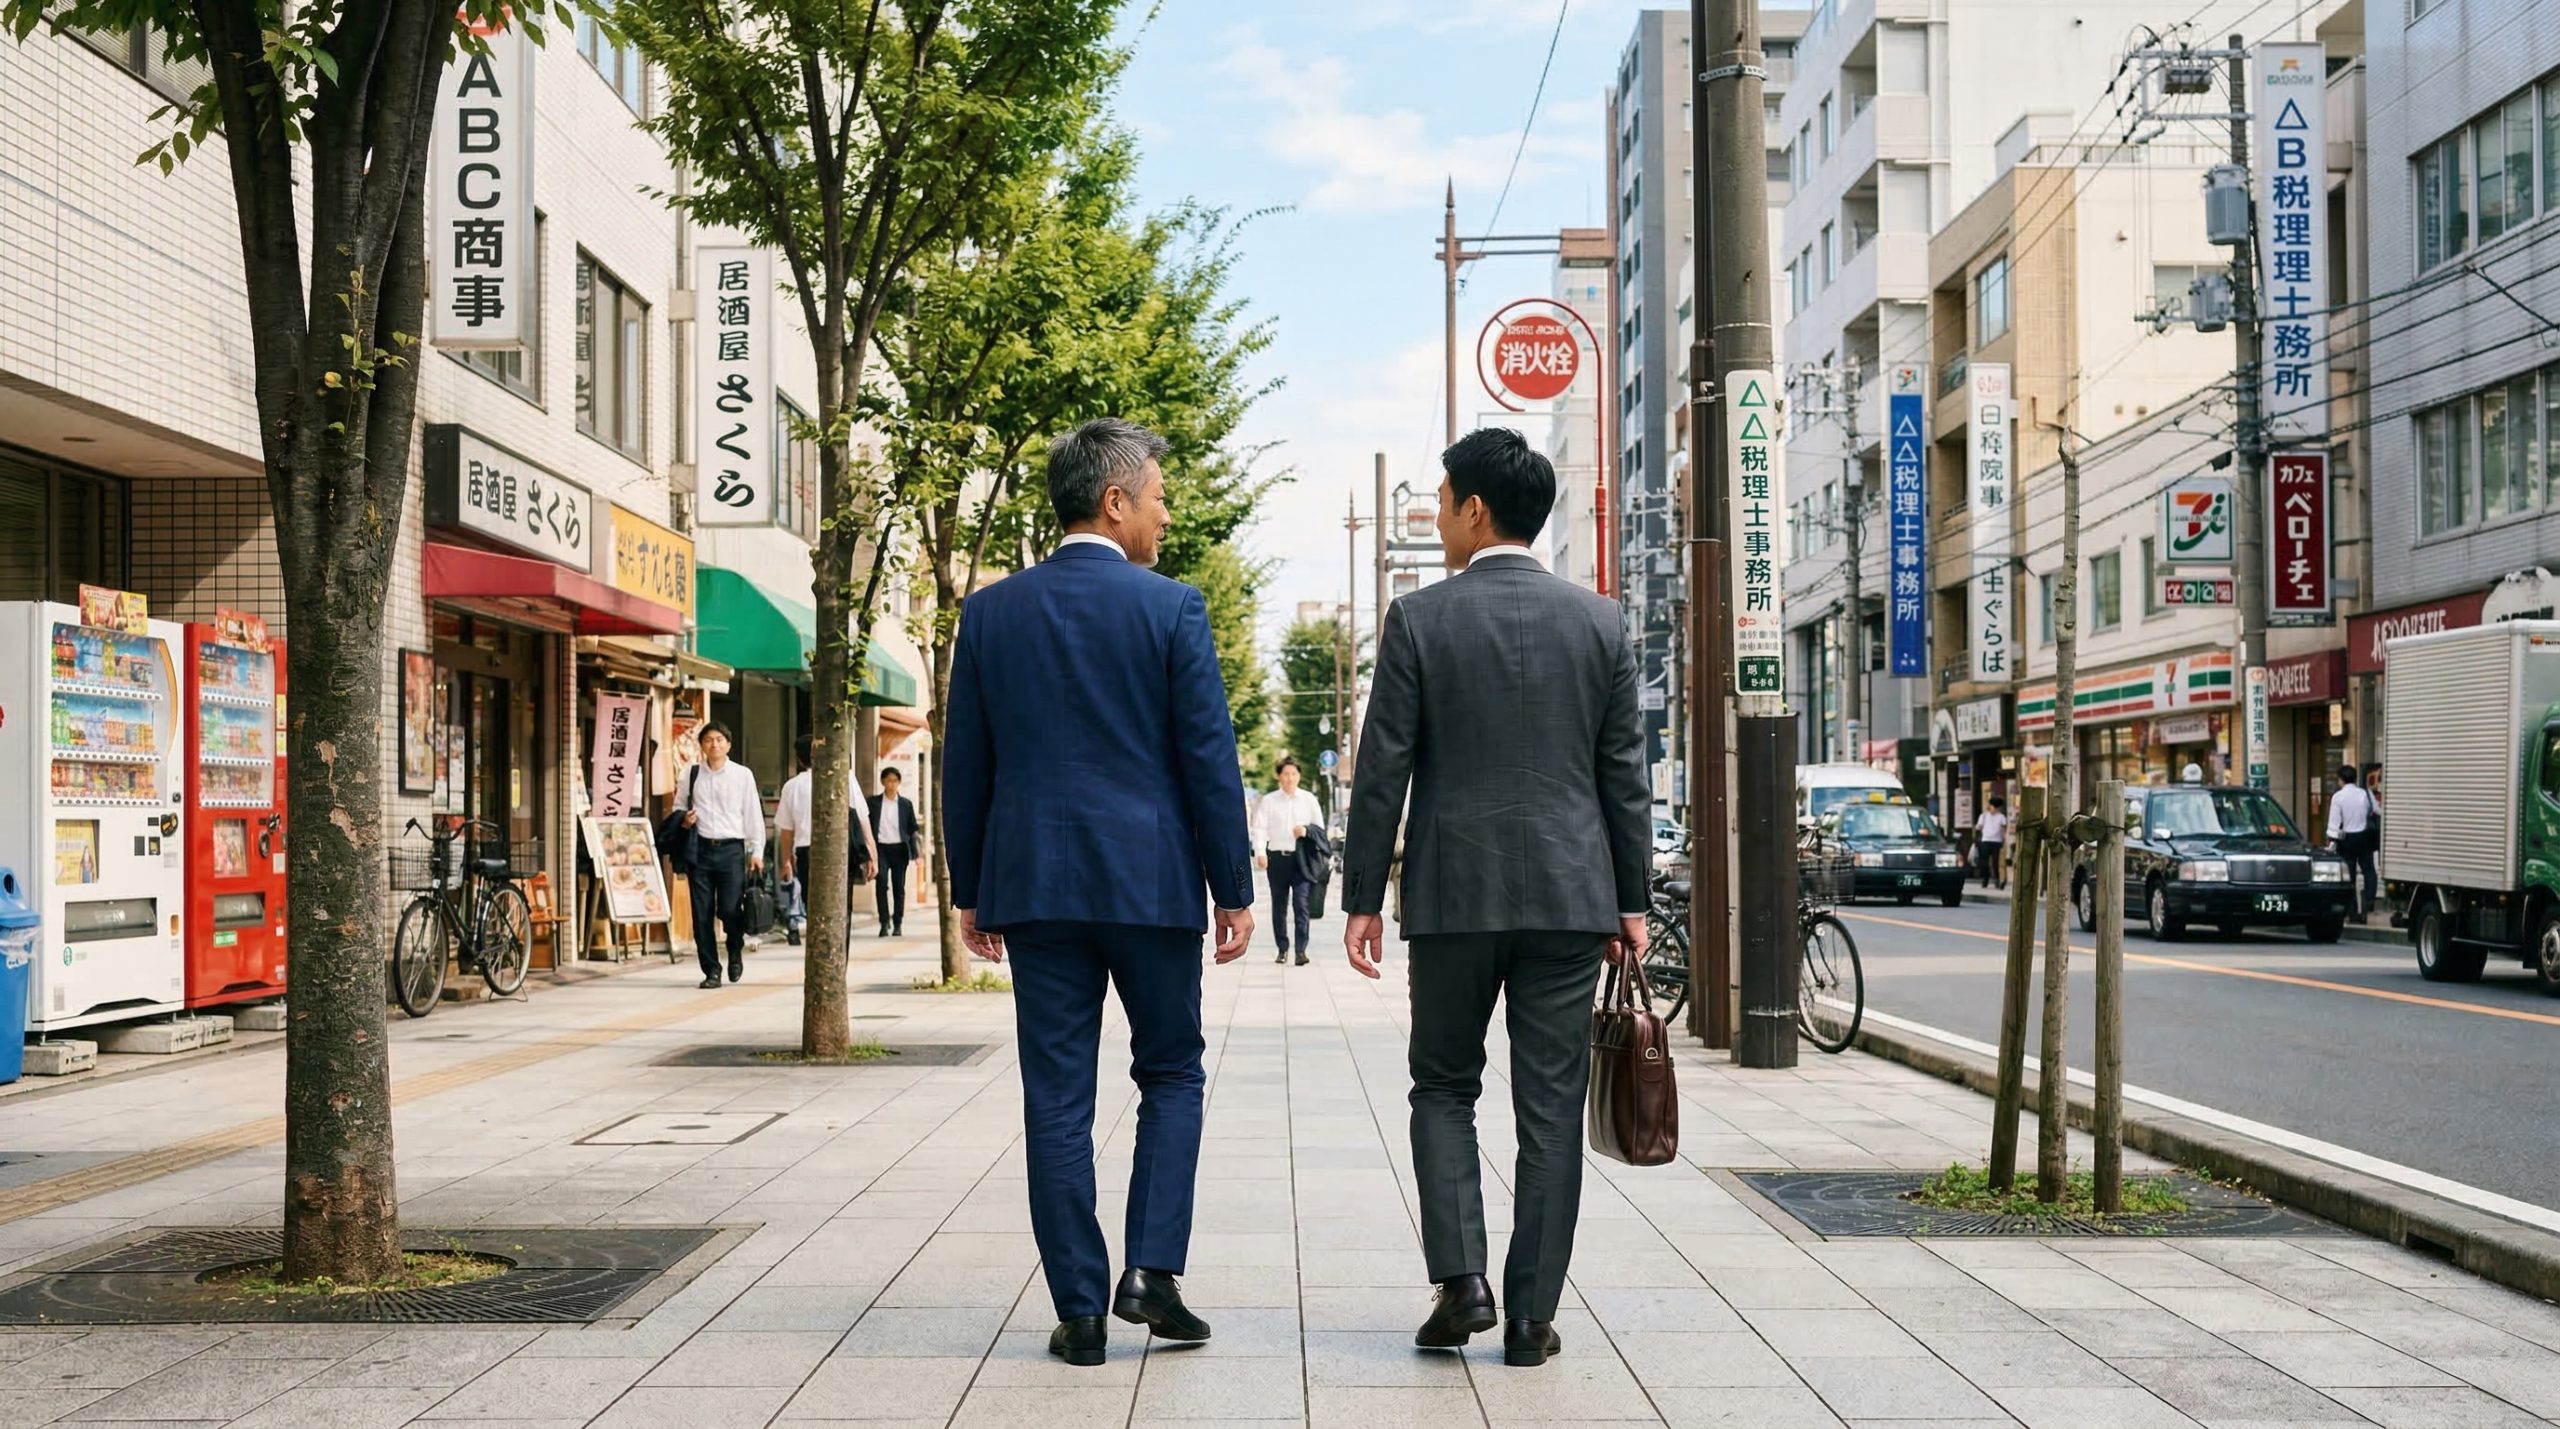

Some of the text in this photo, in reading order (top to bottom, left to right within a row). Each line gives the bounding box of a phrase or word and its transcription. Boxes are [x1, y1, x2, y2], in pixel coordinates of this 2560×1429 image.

[452, 51, 505, 327] ABC商事
[714, 261, 755, 507] 居酒屋さくら
[1500, 341, 1573, 376] 消火栓
[2279, 464, 2316, 483] カフェ
[2285, 492, 2315, 600] ベローチェ
